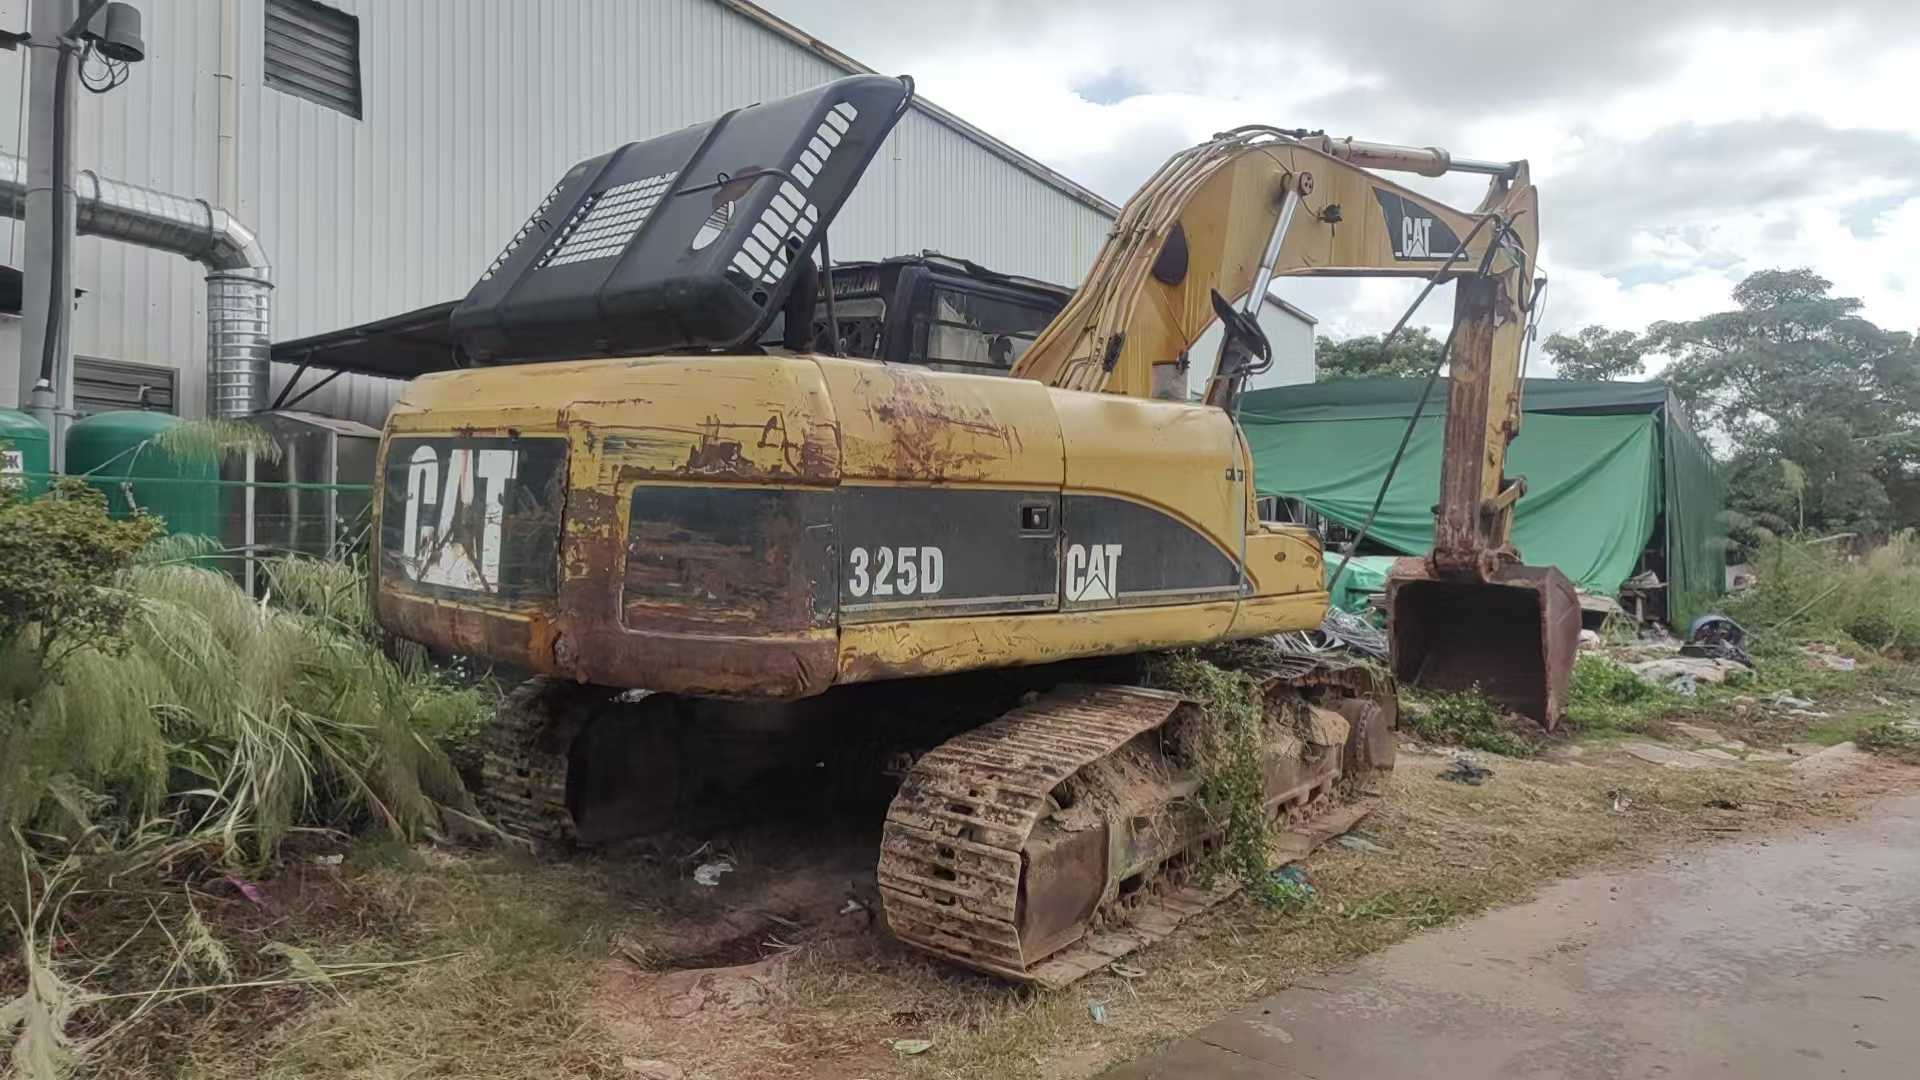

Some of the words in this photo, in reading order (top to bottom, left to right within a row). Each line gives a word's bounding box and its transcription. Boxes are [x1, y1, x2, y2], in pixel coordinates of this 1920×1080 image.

[1402, 216, 1432, 257] CAT
[402, 445, 518, 592] CAT
[849, 546, 944, 597] 325D
[1065, 544, 1123, 602] CAT
